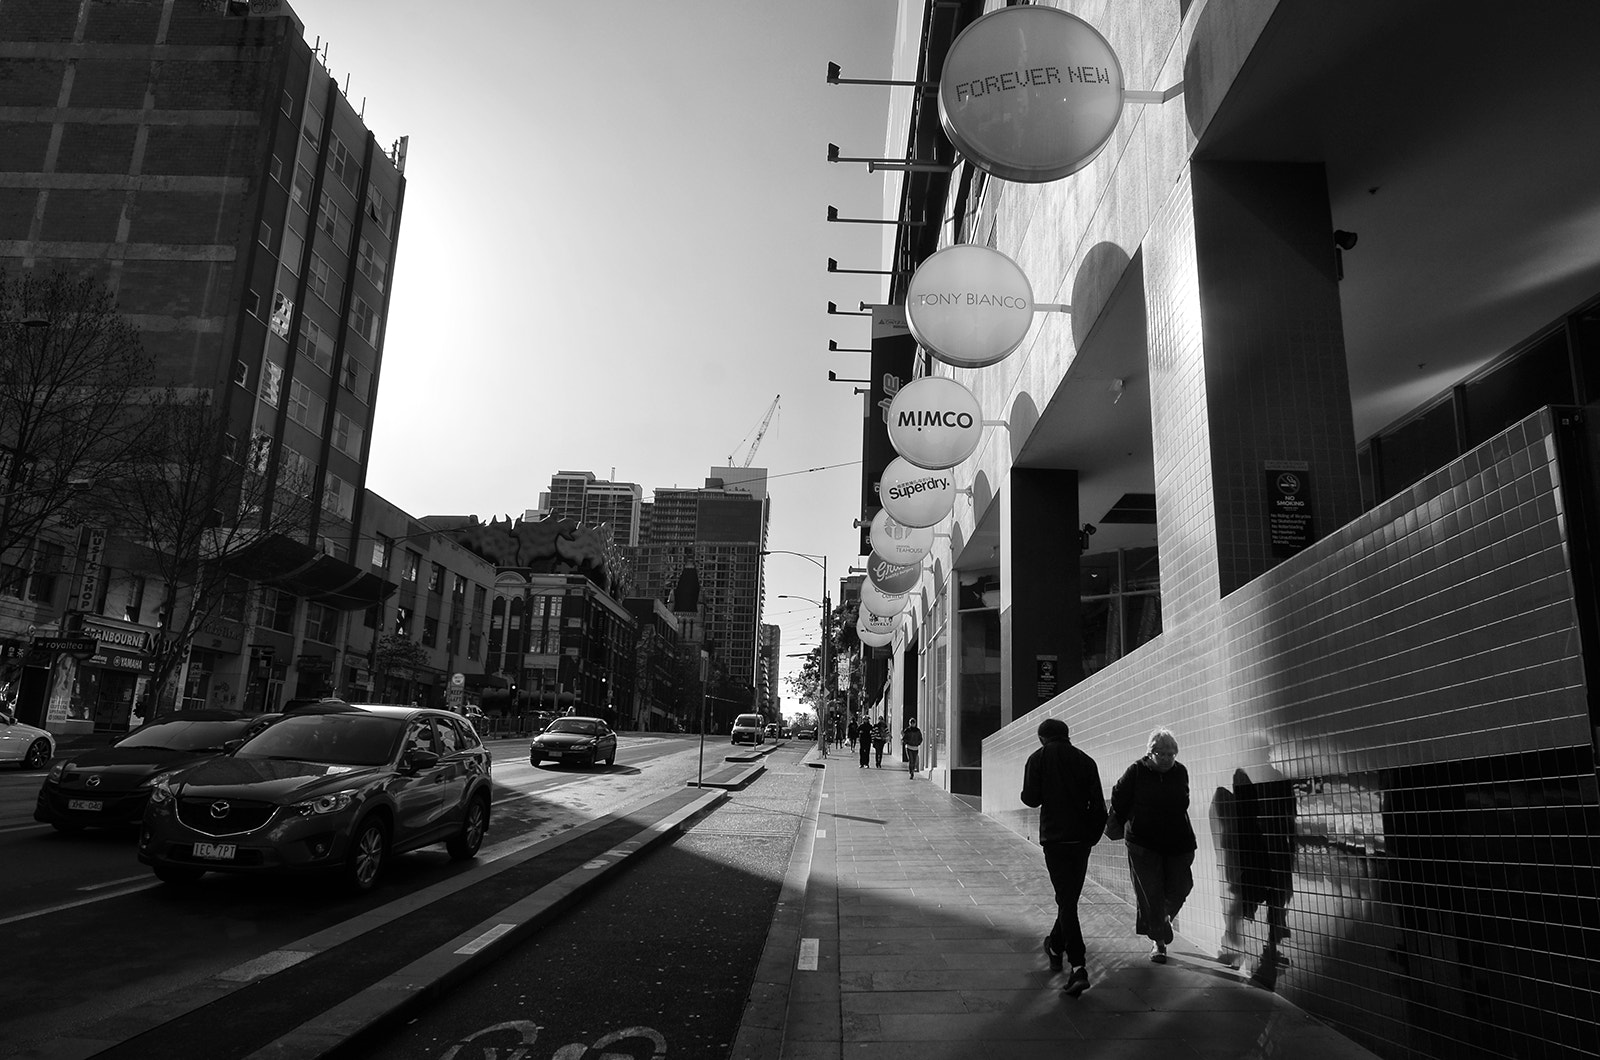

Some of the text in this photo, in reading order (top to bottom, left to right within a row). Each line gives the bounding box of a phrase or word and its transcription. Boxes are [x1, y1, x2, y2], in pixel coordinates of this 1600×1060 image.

[955, 65, 1110, 102] FOREVER NEW
[917, 292, 1026, 310] TONY BIANCO
[889, 478, 950, 500] Superdry.
[82, 577, 94, 608] SHOP
[45, 641, 84, 650] royaltea
[120, 656, 143, 670] YAMAHA
[218, 845, 235, 857] 7PT
